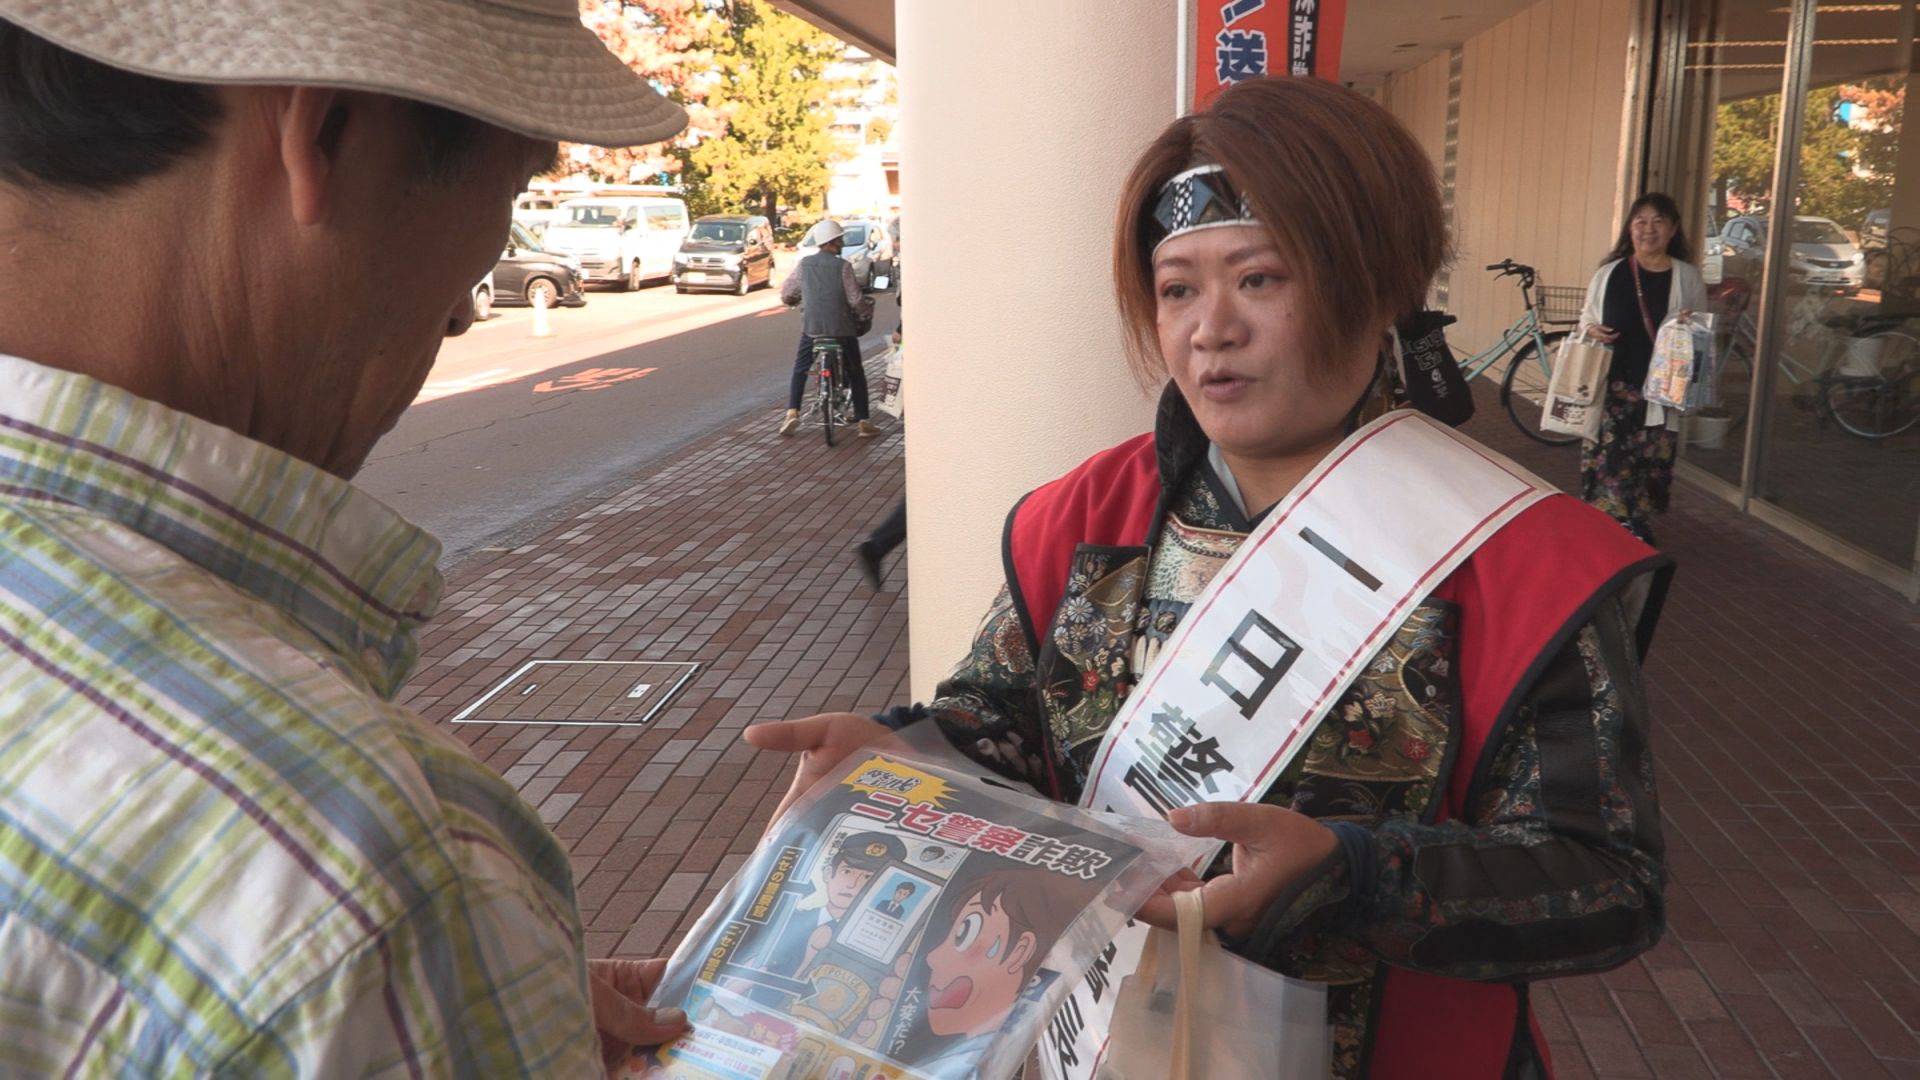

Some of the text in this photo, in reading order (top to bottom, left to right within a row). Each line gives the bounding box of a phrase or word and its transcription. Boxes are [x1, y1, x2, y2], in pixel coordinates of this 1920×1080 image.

[850, 791, 1112, 879] ニセ警察詐欺
